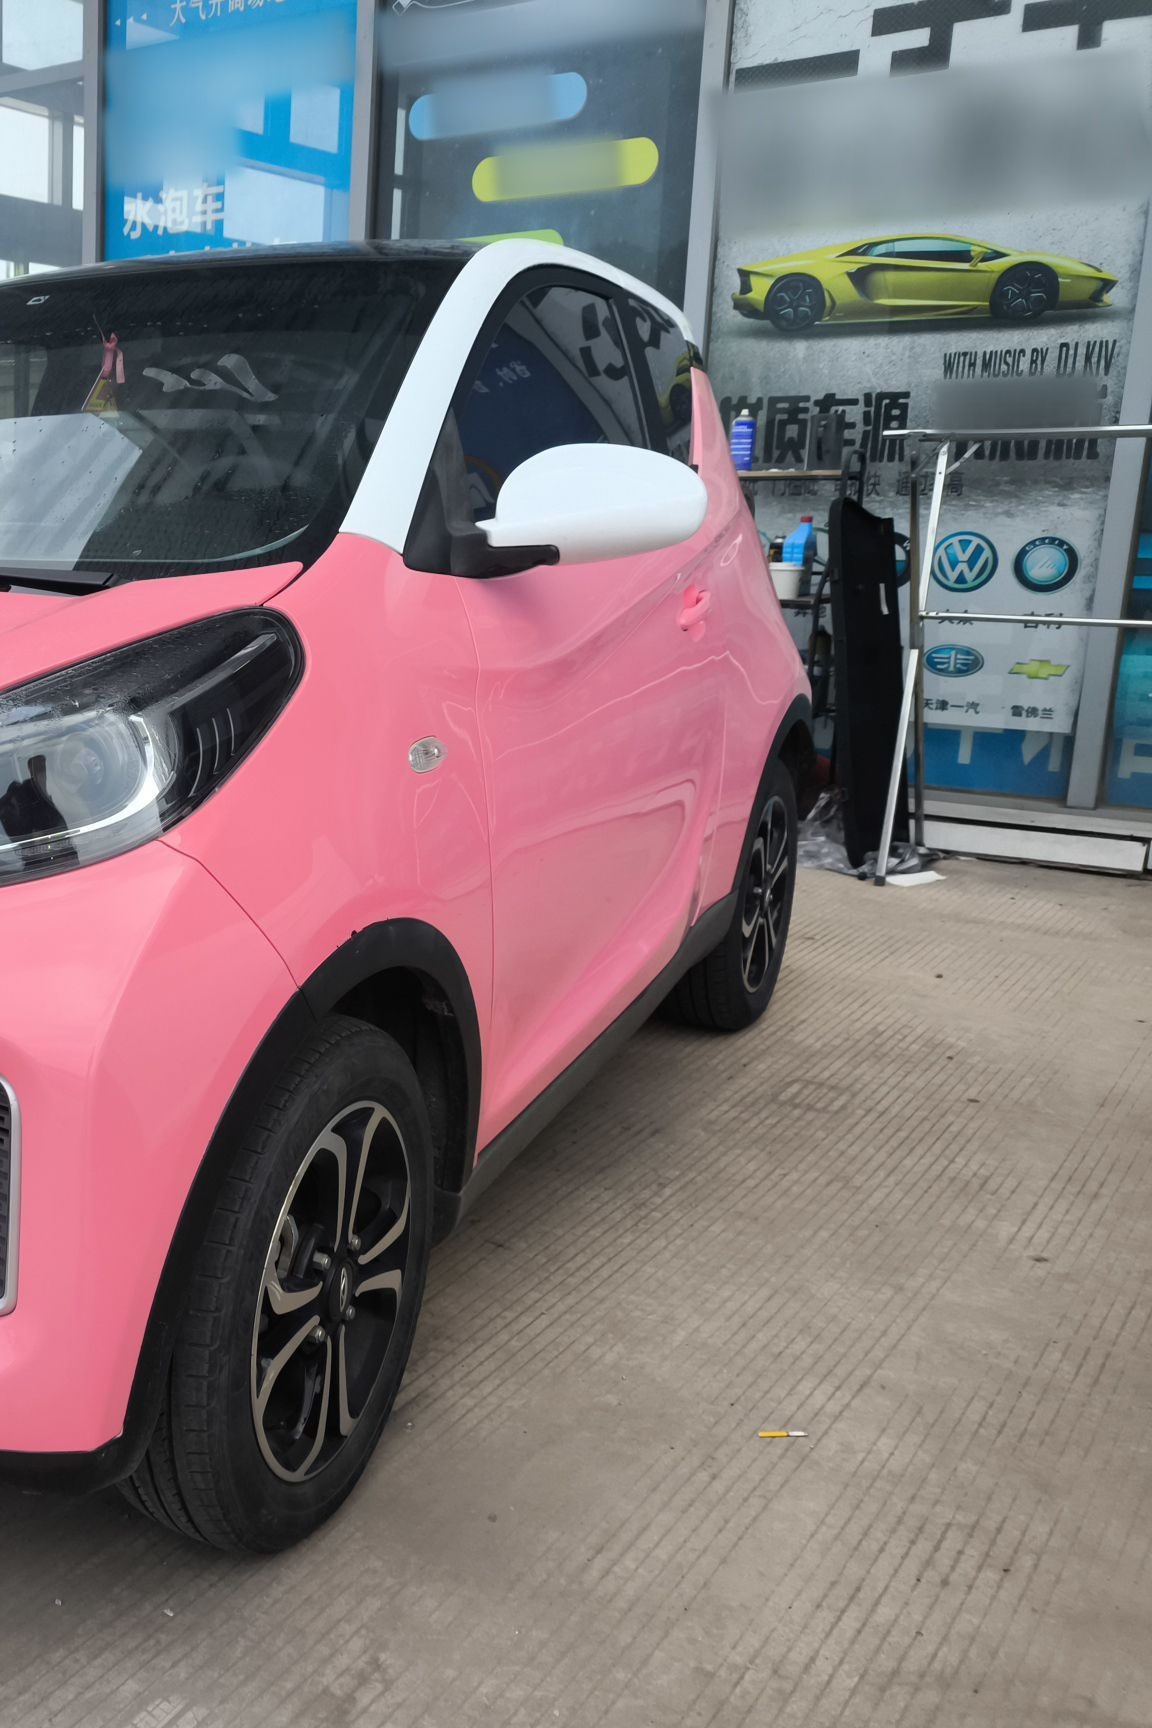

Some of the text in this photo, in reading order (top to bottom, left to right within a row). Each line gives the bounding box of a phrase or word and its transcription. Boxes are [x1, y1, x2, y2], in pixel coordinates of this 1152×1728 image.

[123, 182, 224, 239] 水泡车
[943, 339, 1117, 379] WITH MUSIC BY DJ KIV
[923, 698, 980, 714] 天津一汽
[1010, 705, 1055, 719] 雪佛兰
